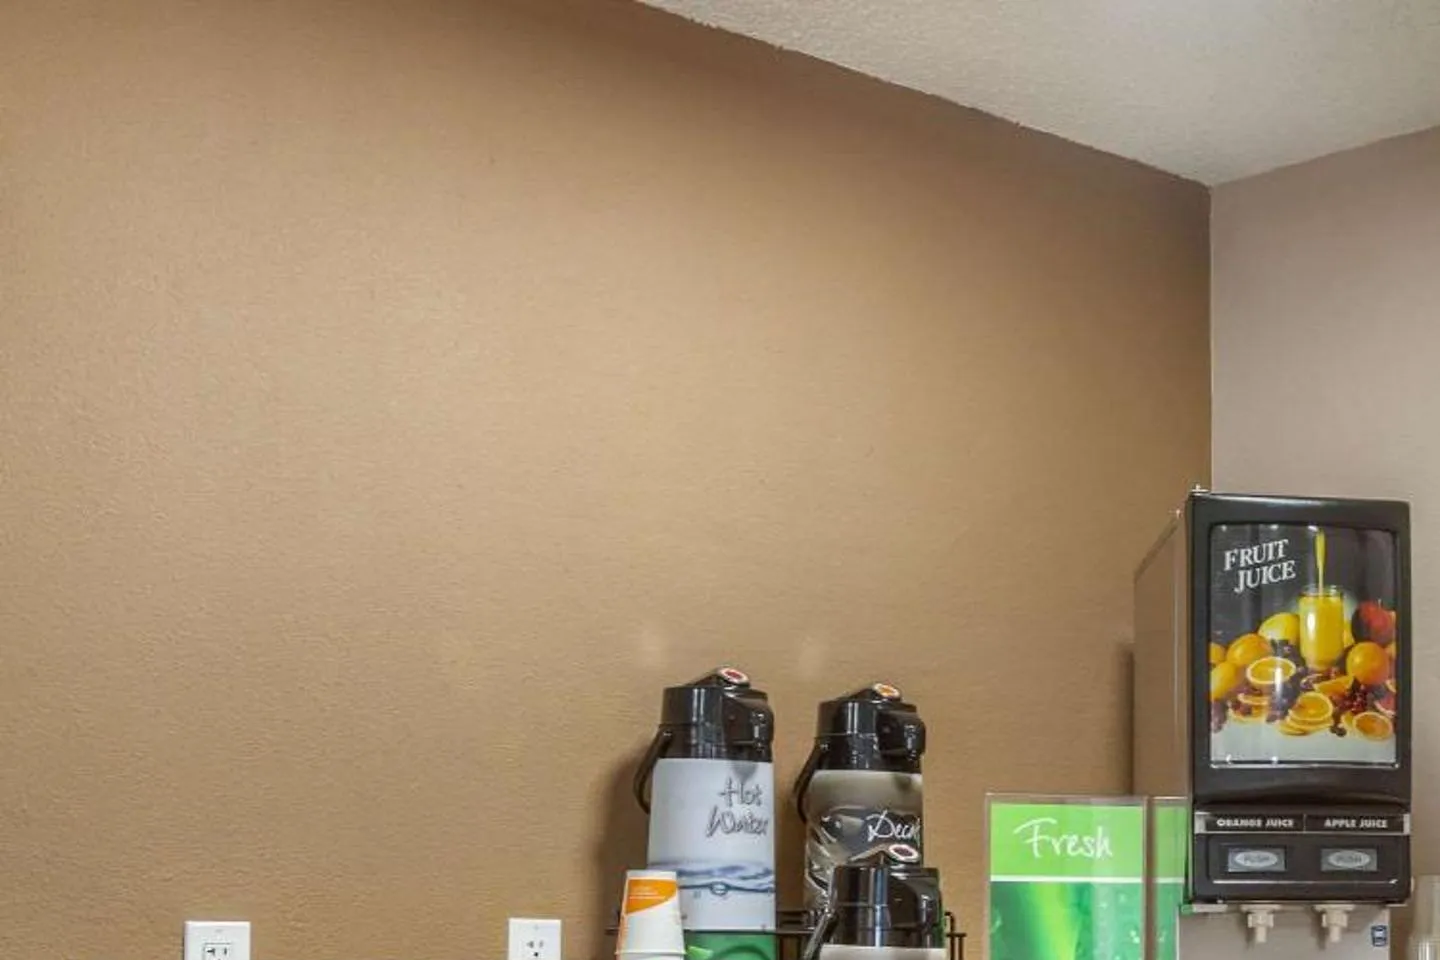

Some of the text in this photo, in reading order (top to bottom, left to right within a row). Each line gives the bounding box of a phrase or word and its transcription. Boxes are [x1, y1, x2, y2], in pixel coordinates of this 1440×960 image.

[1223, 538, 1289, 572] FRUIT
[1233, 560, 1296, 594] JUICE
[717, 777, 763, 807] Hot
[1012, 816, 1114, 859] Fresh
[1216, 818, 1295, 828] ORANGE JUICE
[1324, 818, 1388, 829] APPLE JUICE
